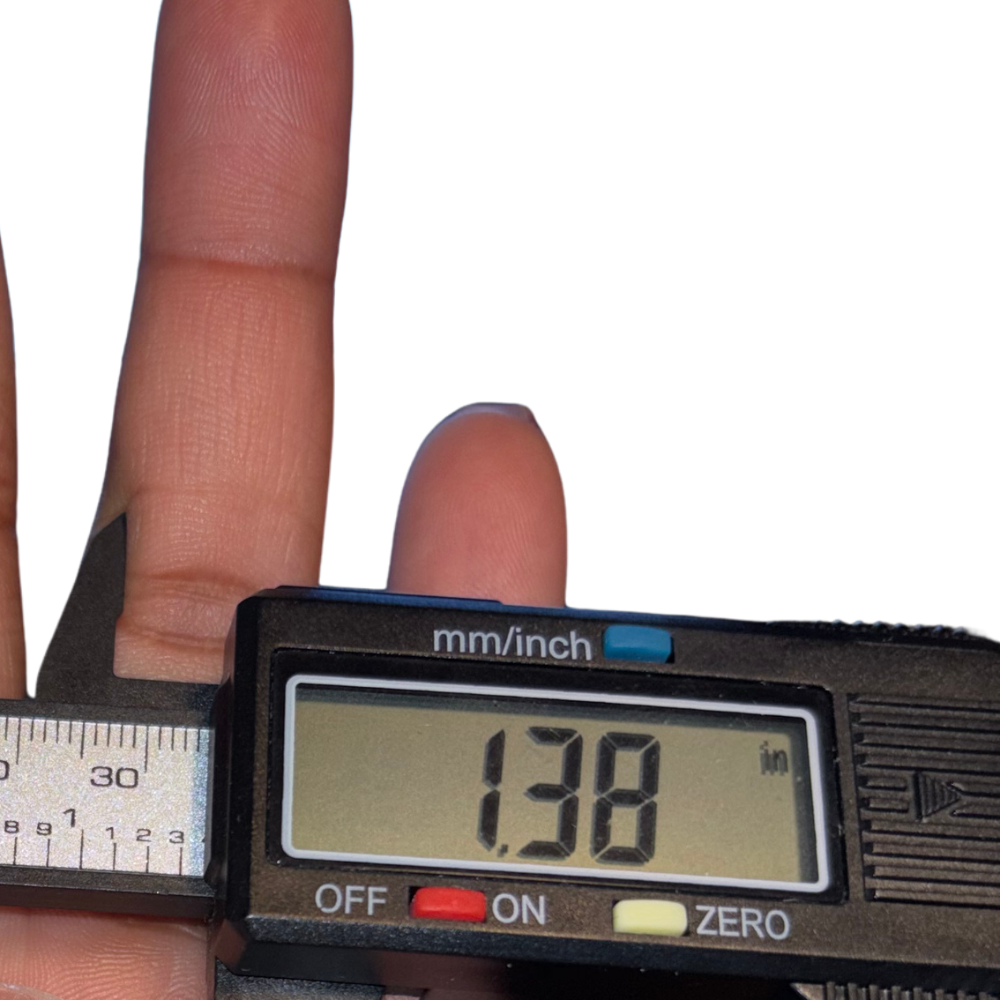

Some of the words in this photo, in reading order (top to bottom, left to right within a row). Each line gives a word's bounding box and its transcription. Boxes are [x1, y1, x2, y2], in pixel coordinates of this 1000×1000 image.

[433, 626, 592, 661] mm/inch
[90, 765, 139, 789] 30
[476, 725, 661, 866] 1.38
[759, 741, 789, 776] in
[4, 820, 20, 834] 8
[36, 822, 53, 837] 9
[63, 808, 76, 828] 1
[105, 826, 115, 840] 1
[135, 828, 152, 842] 2
[169, 830, 185, 844] 3
[315, 883, 388, 916] OFF
[492, 892, 546, 926] ON
[695, 904, 790, 940] ZERO
